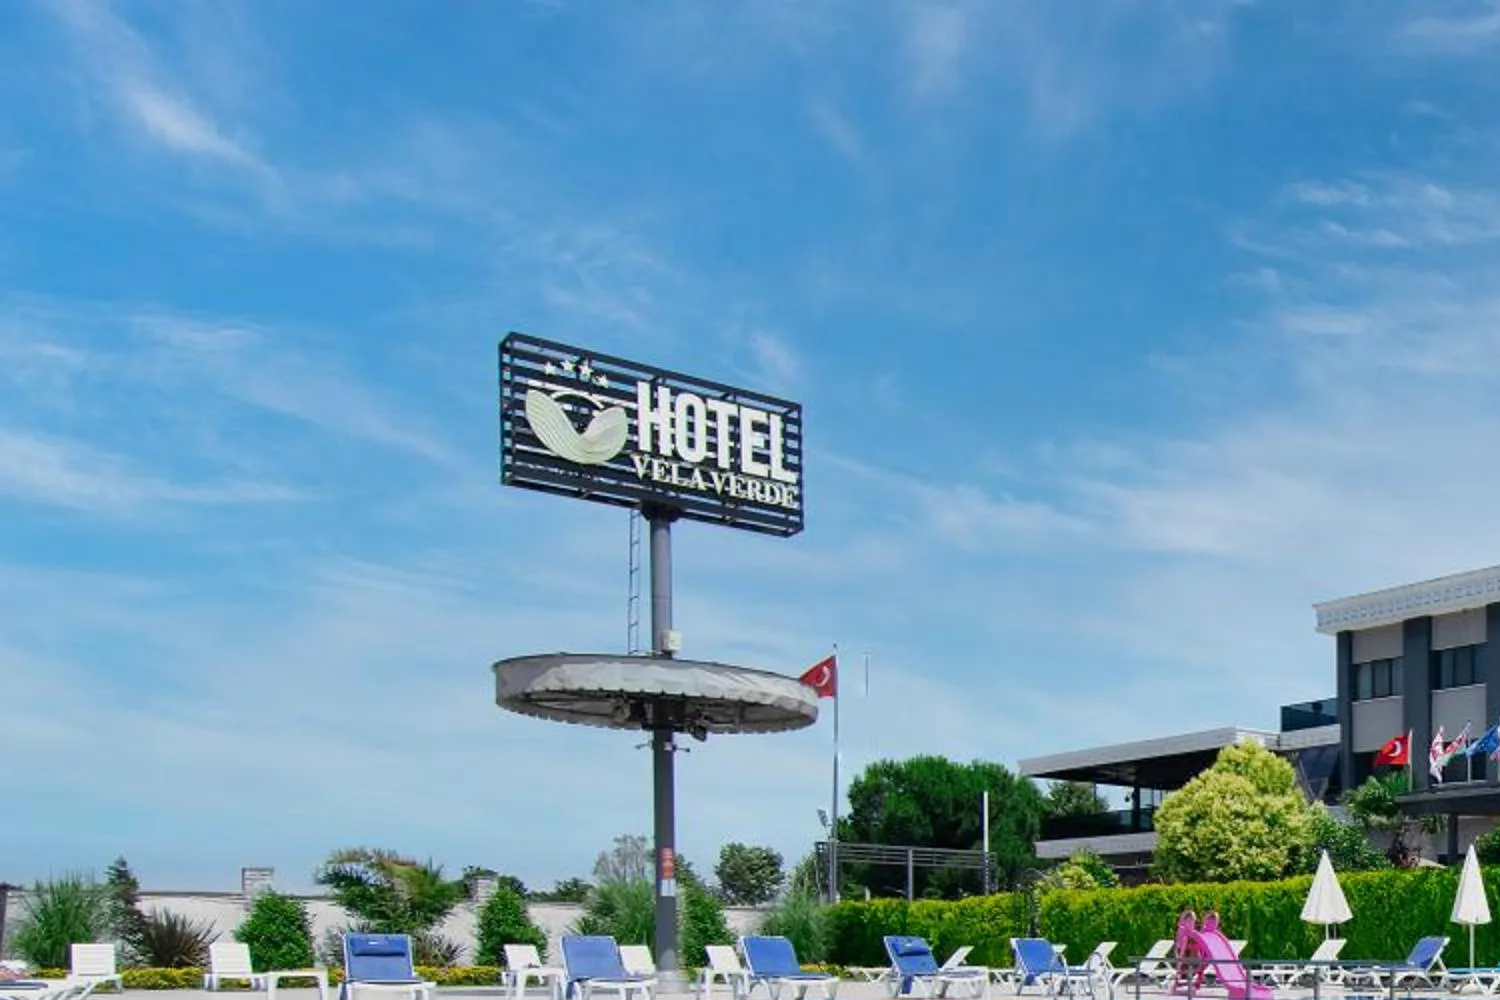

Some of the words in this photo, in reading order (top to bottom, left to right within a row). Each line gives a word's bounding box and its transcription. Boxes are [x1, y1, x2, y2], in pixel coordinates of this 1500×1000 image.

[637, 381, 799, 484] HOTEL
[630, 453, 707, 491] VELA
[710, 471, 799, 510] VERDE
